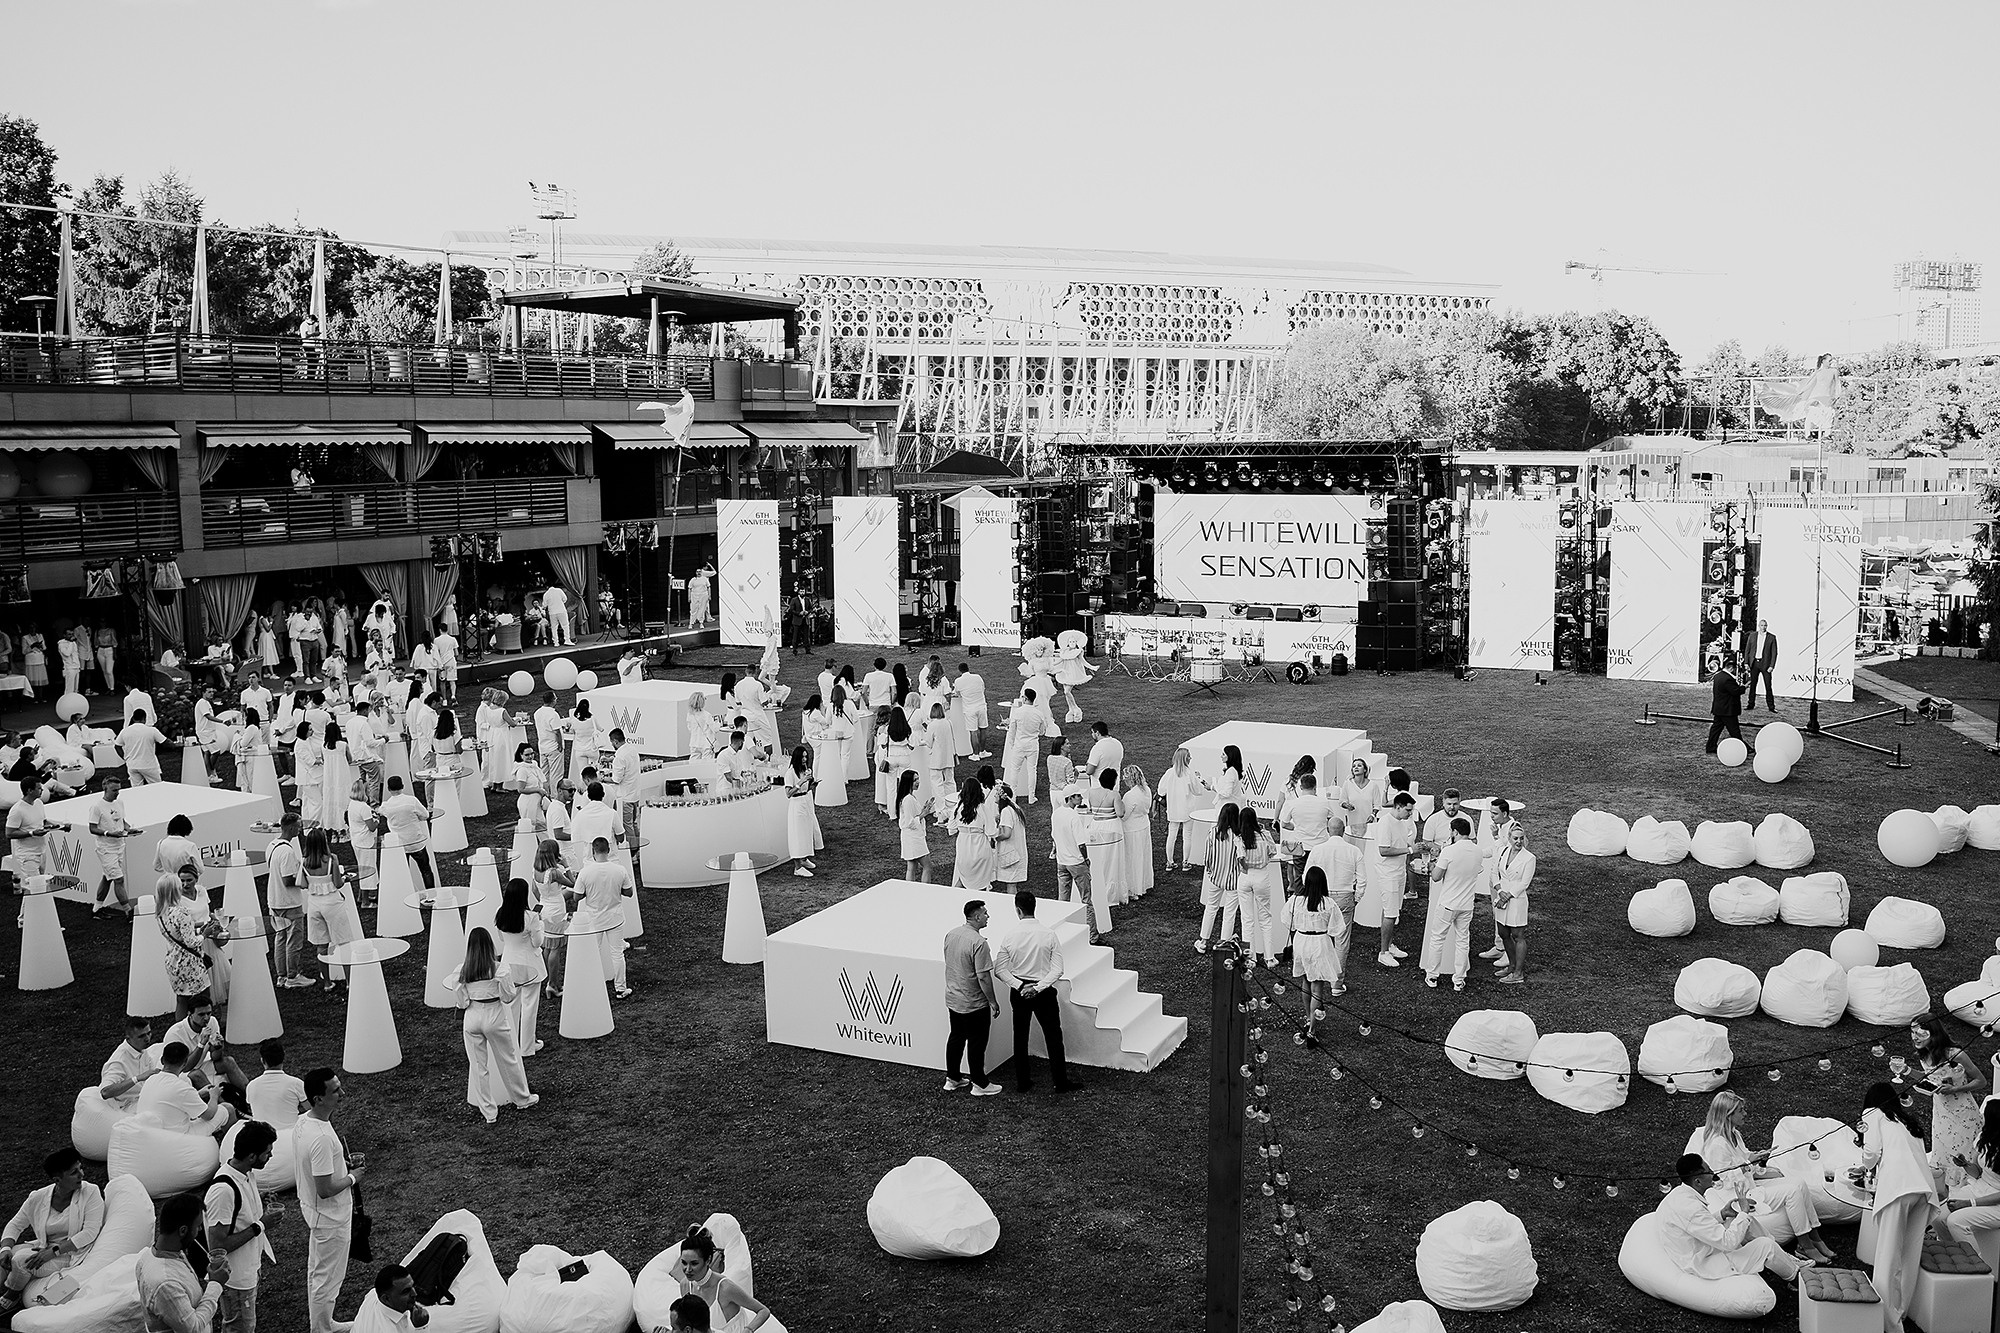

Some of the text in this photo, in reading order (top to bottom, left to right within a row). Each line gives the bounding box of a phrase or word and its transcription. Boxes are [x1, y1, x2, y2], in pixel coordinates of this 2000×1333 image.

[1200, 521, 1366, 544] WHITEWILL
[1201, 555, 1366, 580] SENSATION
[1291, 642, 1351, 651] ANNIVERSARY
[1520, 641, 1552, 649] WHITE
[1608, 648, 1632, 656] WILL
[1608, 656, 1632, 664] TION
[1818, 667, 1840, 676] 6TH
[1790, 674, 1851, 686] ANNVERSA
[836, 1022, 912, 1048] Whitewill
